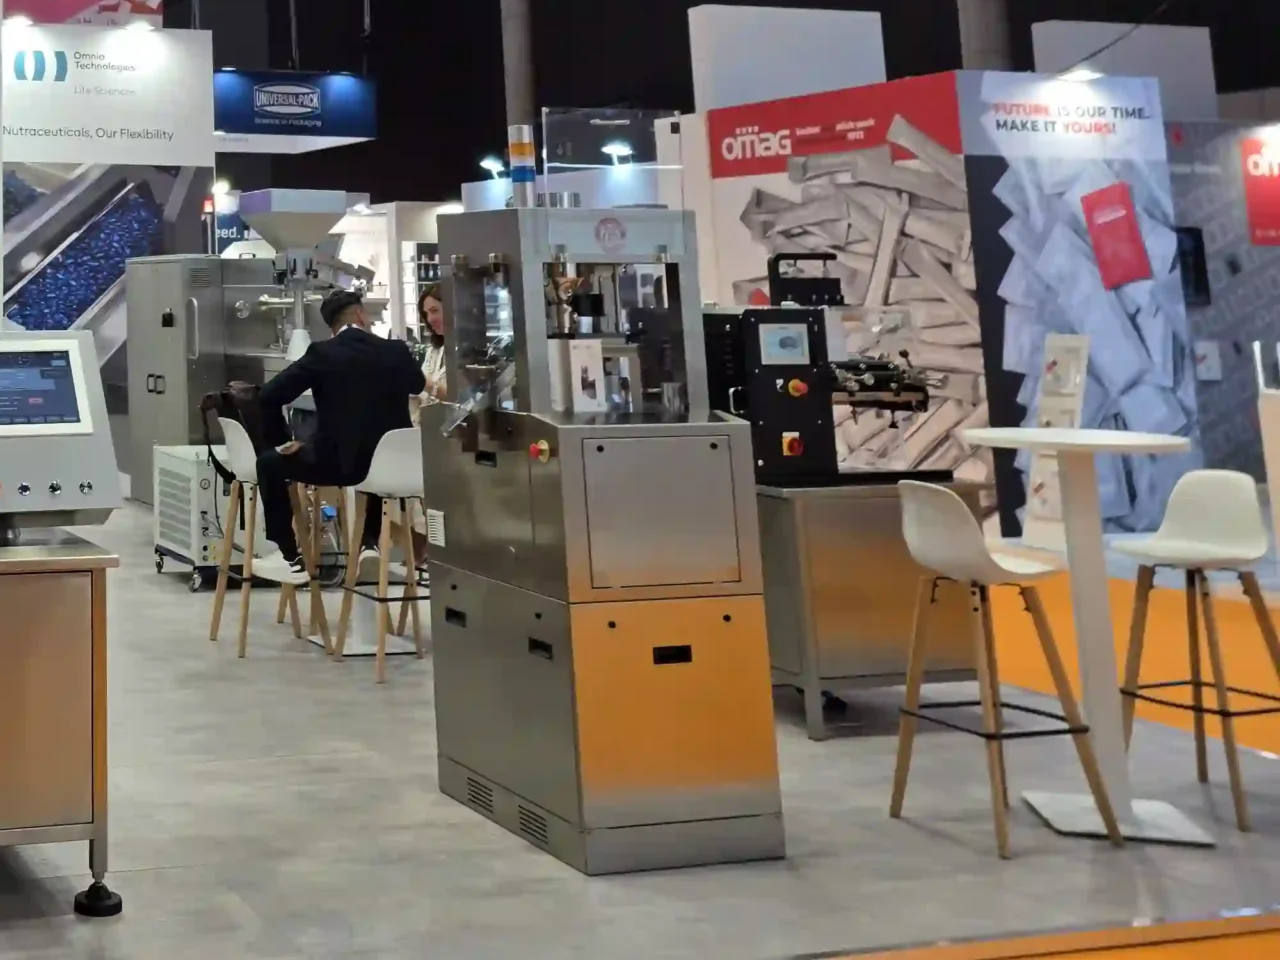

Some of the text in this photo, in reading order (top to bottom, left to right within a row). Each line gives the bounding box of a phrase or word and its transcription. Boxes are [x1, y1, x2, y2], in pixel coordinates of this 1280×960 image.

[74, 51, 105, 61] Omnia
[996, 119, 1039, 132] MAKE
[1045, 120, 1057, 132] IT
[2, 126, 174, 142] Nutraceuticals, Our Flexibility
